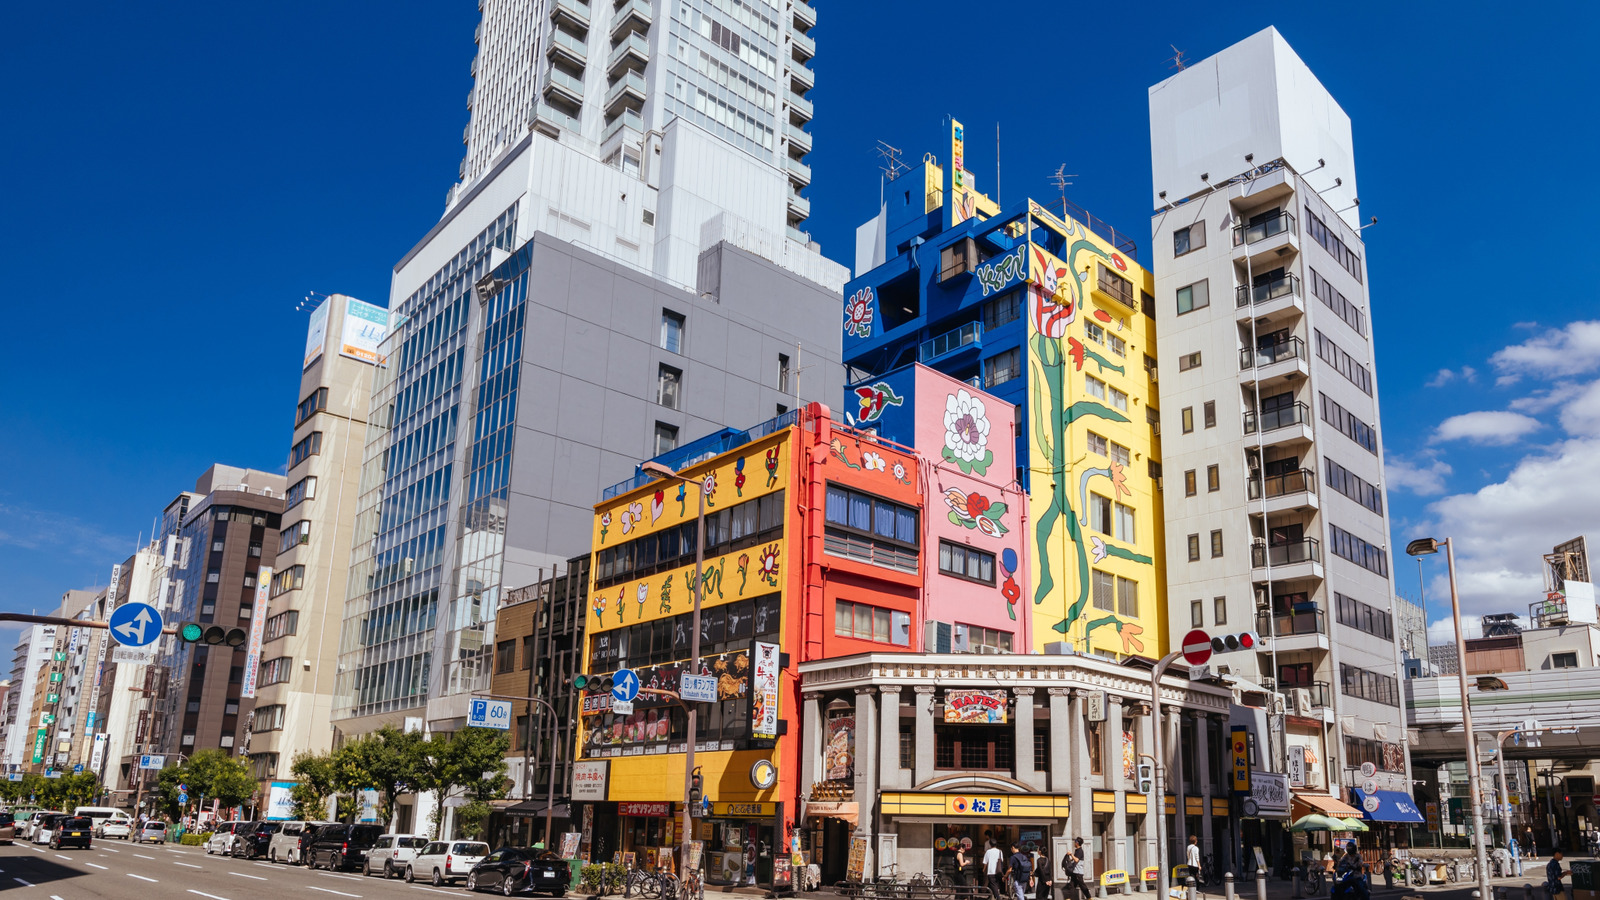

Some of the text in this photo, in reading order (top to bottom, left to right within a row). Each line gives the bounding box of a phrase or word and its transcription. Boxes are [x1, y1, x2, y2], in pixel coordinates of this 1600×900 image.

[113, 651, 149, 661] 自転車を除く
[684, 677, 714, 691] 四ツ橋ランプ西
[476, 702, 484, 713] P
[951, 694, 1001, 710] HAFEZ
[1235, 757, 1246, 781] 松屋
[628, 803, 665, 814] ナポリタン専門店
[734, 804, 762, 814] CoCo壱番屋
[972, 798, 1002, 813] 松屋
